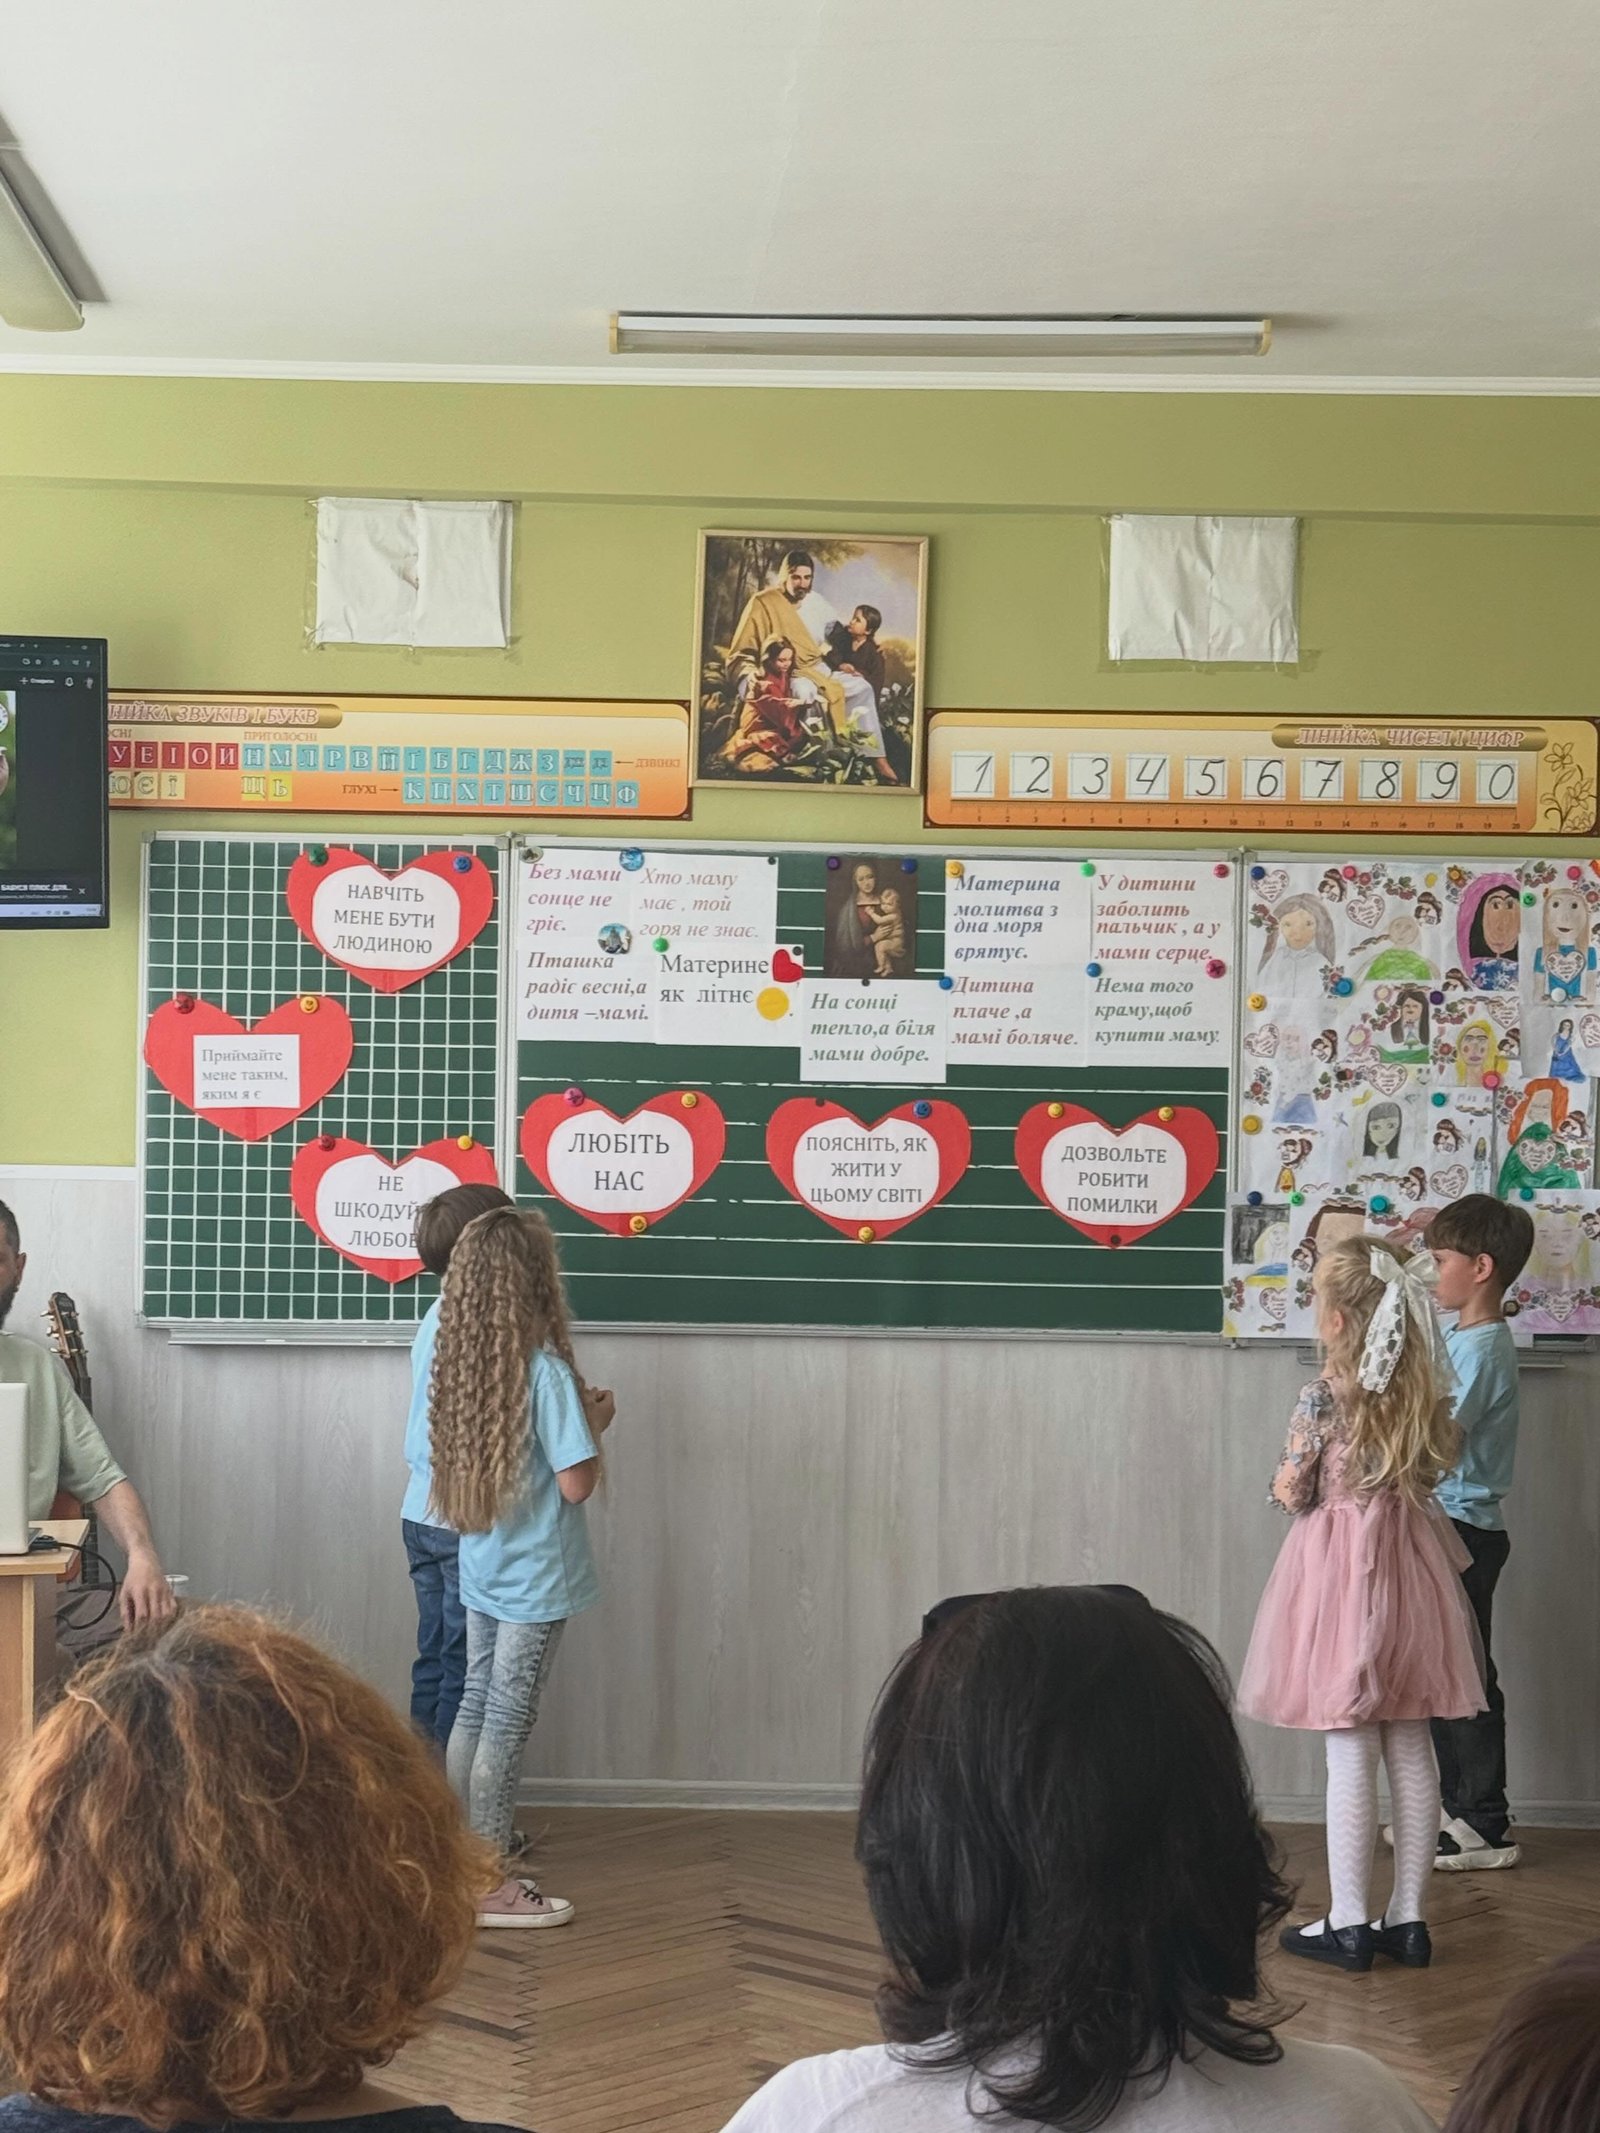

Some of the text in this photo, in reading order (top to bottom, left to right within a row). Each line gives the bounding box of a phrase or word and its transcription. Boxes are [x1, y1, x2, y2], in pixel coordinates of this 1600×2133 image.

[176, 704, 250, 723] ЗВУКІВ
[252, 706, 261, 723] І
[264, 706, 319, 724] БУКВ
[108, 728, 132, 739] СНІ
[1295, 724, 1525, 749] ЛІНІЙКА ЧИСЕЛ І ЦИФР
[111, 745, 128, 763] У
[140, 746, 154, 764] Е
[170, 747, 177, 764] І
[191, 747, 209, 765] О
[219, 748, 236, 766] И
[245, 748, 264, 767] Н
[270, 748, 292, 767] М
[299, 749, 318, 767] Л
[327, 750, 341, 768] Р
[353, 750, 369, 769] В
[380, 749, 398, 771] Й
[434, 752, 449, 770] Б
[460, 752, 476, 770] Г
[484, 751, 505, 773] Д
[510, 753, 533, 772] Ж
[541, 754, 555, 772] З
[975, 755, 1514, 800] 1 2 3 4 5 6 7 8 9 0
[405, 782, 636, 805] К П Х Т Ш С Ч Ц Ф
[528, 863, 622, 882] Без мами
[640, 868, 738, 890] Хто маму
[954, 875, 1061, 896] Материна
[1098, 874, 1197, 892] У дитини
[347, 884, 425, 903] НАВЧІТЬ
[528, 893, 613, 909] сонце не
[638, 898, 677, 910] має
[692, 895, 732, 912] той
[953, 904, 1059, 917] молитва з
[1096, 900, 1190, 917] заболить
[333, 909, 435, 928] МЕНЕ БУТИ
[526, 915, 566, 936] гріє.
[954, 917, 1043, 937] дна моря
[639, 924, 759, 938] горя не знає.
[1095, 922, 1178, 934] пальчик
[1193, 922, 1205, 934] а
[1207, 922, 1221, 939] у
[333, 935, 432, 954] ЛЮДИНОЮ
[527, 952, 615, 968] Пташка
[954, 947, 1028, 963] врятує.
[1095, 947, 1213, 964] мами серце.
[660, 954, 769, 978] Материне
[524, 978, 577, 998] радіє
[660, 984, 754, 1003] як літнє
[950, 976, 1034, 995] Дитина
[1094, 978, 1194, 993] Нема того
[811, 993, 898, 1012] На сонці
[527, 1004, 579, 1020] дитя
[953, 1007, 1010, 1019] плаче
[895, 1019, 936, 1036] біля
[951, 1028, 1078, 1045] мамі боляче.
[1095, 1030, 1165, 1046] купити
[202, 1049, 283, 1065] Приймайте
[808, 1045, 930, 1065] мами добре.
[202, 1071, 237, 1081] мене
[202, 1090, 238, 1100] яким
[242, 1090, 250, 1100] я
[568, 1133, 670, 1154] ЛЮБІТЬ
[806, 1136, 928, 1153] ПОЯСНІТЬ, ЯК
[1061, 1145, 1167, 1163] ДОЗВОЛЬТЕ
[831, 1162, 902, 1177] ЖИТИ У
[378, 1176, 404, 1191] НЕ
[594, 1170, 644, 1191] НАС
[1078, 1171, 1149, 1188] РОБИТИ
[811, 1188, 922, 1204] ЦЬОМУ СВІТІ
[1066, 1197, 1158, 1214] ПОМИЛКИ
